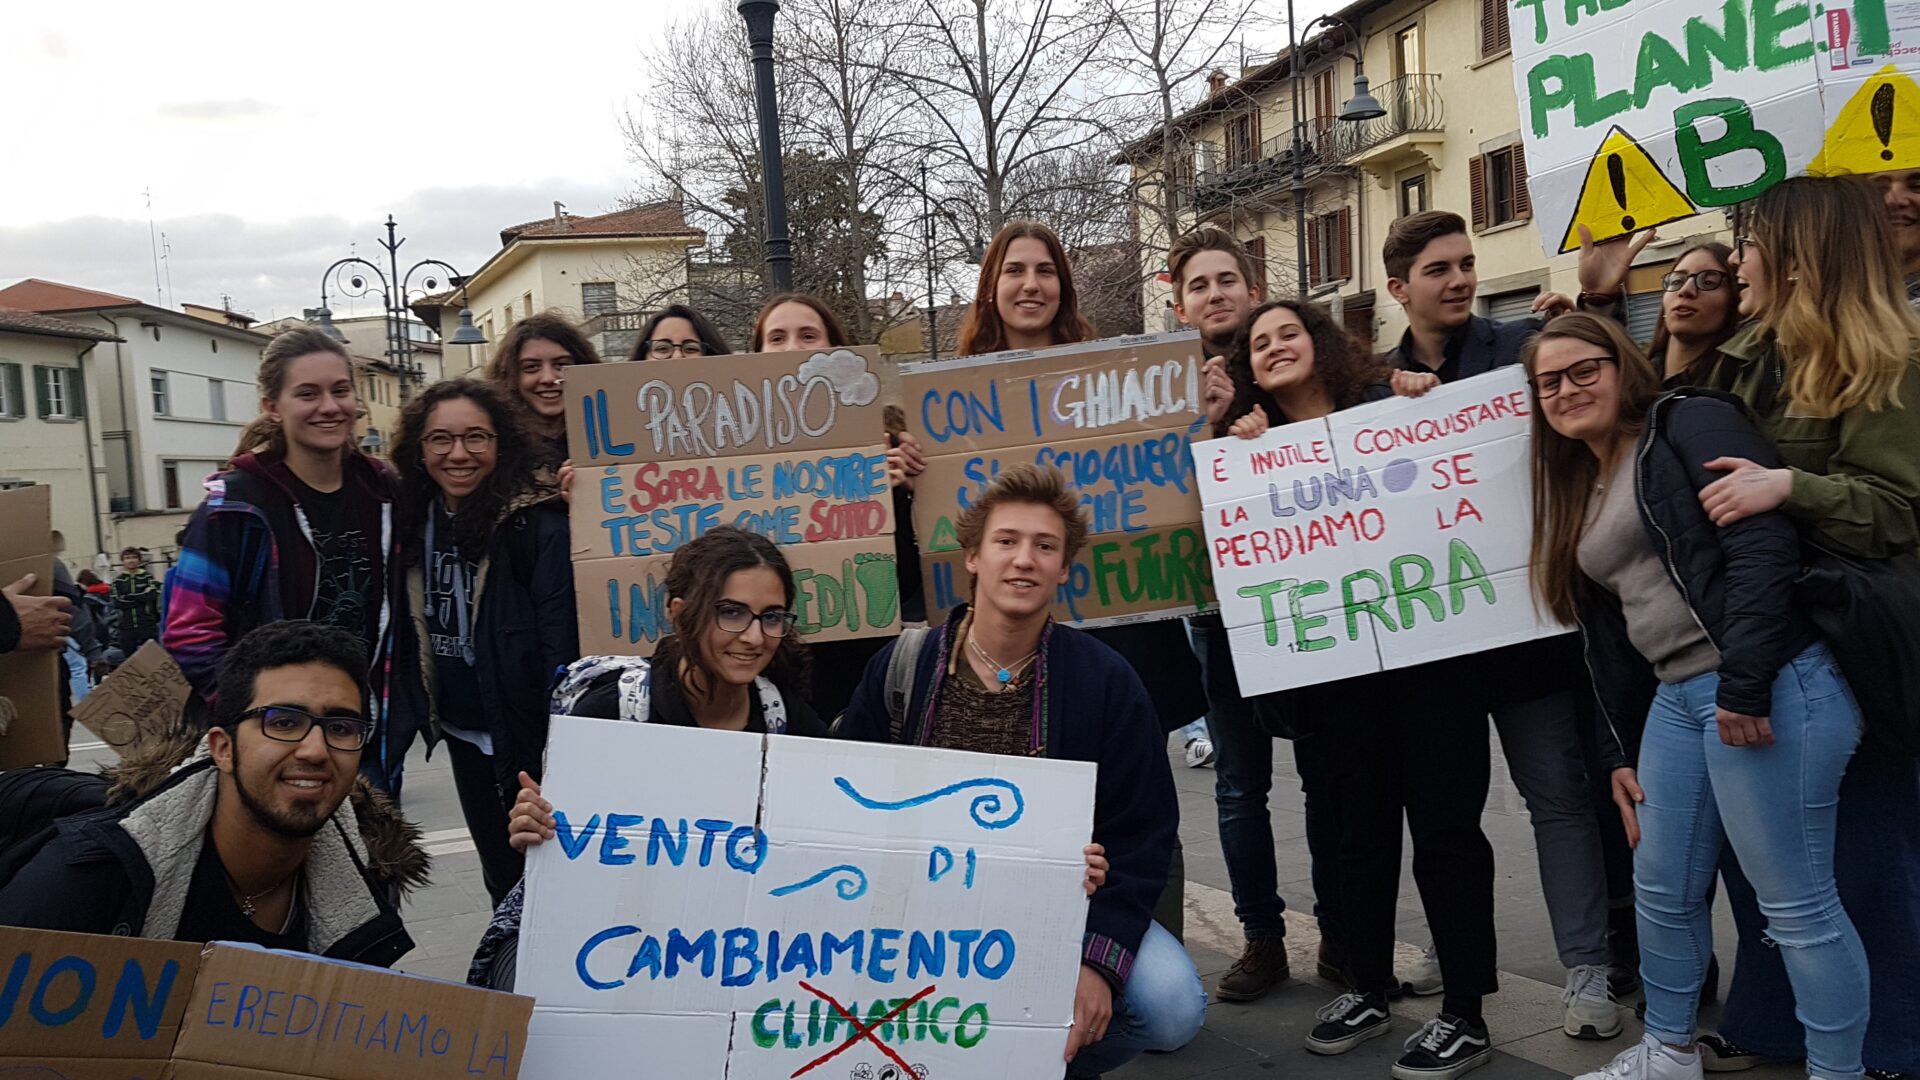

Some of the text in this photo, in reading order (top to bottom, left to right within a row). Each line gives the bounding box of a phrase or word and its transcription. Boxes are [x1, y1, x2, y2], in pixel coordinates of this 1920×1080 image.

[1831, 12, 1841, 48] STANDARD
[1673, 97, 1788, 208] B
[583, 374, 838, 459] IL PARADISO
[921, 355, 1200, 443] CON I GHIACCI
[1212, 391, 1531, 483] È INUTILE CONQUISTARE
[629, 463, 724, 513] SOPRA
[728, 464, 764, 501] LE
[772, 452, 888, 503] NOSTRE
[1221, 453, 1479, 528] LA LUNA SE
[601, 503, 725, 557] TESTE
[805, 500, 888, 543] SOTTO
[1214, 497, 1484, 568] PERDIAMO LA
[791, 558, 861, 636] EDI
[932, 561, 964, 611] IL
[1237, 538, 1497, 652] TERRA
[551, 810, 978, 889] VENTO DI
[575, 925, 1016, 991] CAMBIAMENTO
[207, 981, 452, 1058] EREDITIAMO
[466, 1028, 511, 1076] LA
[750, 996, 990, 1050] CLIMATICO
